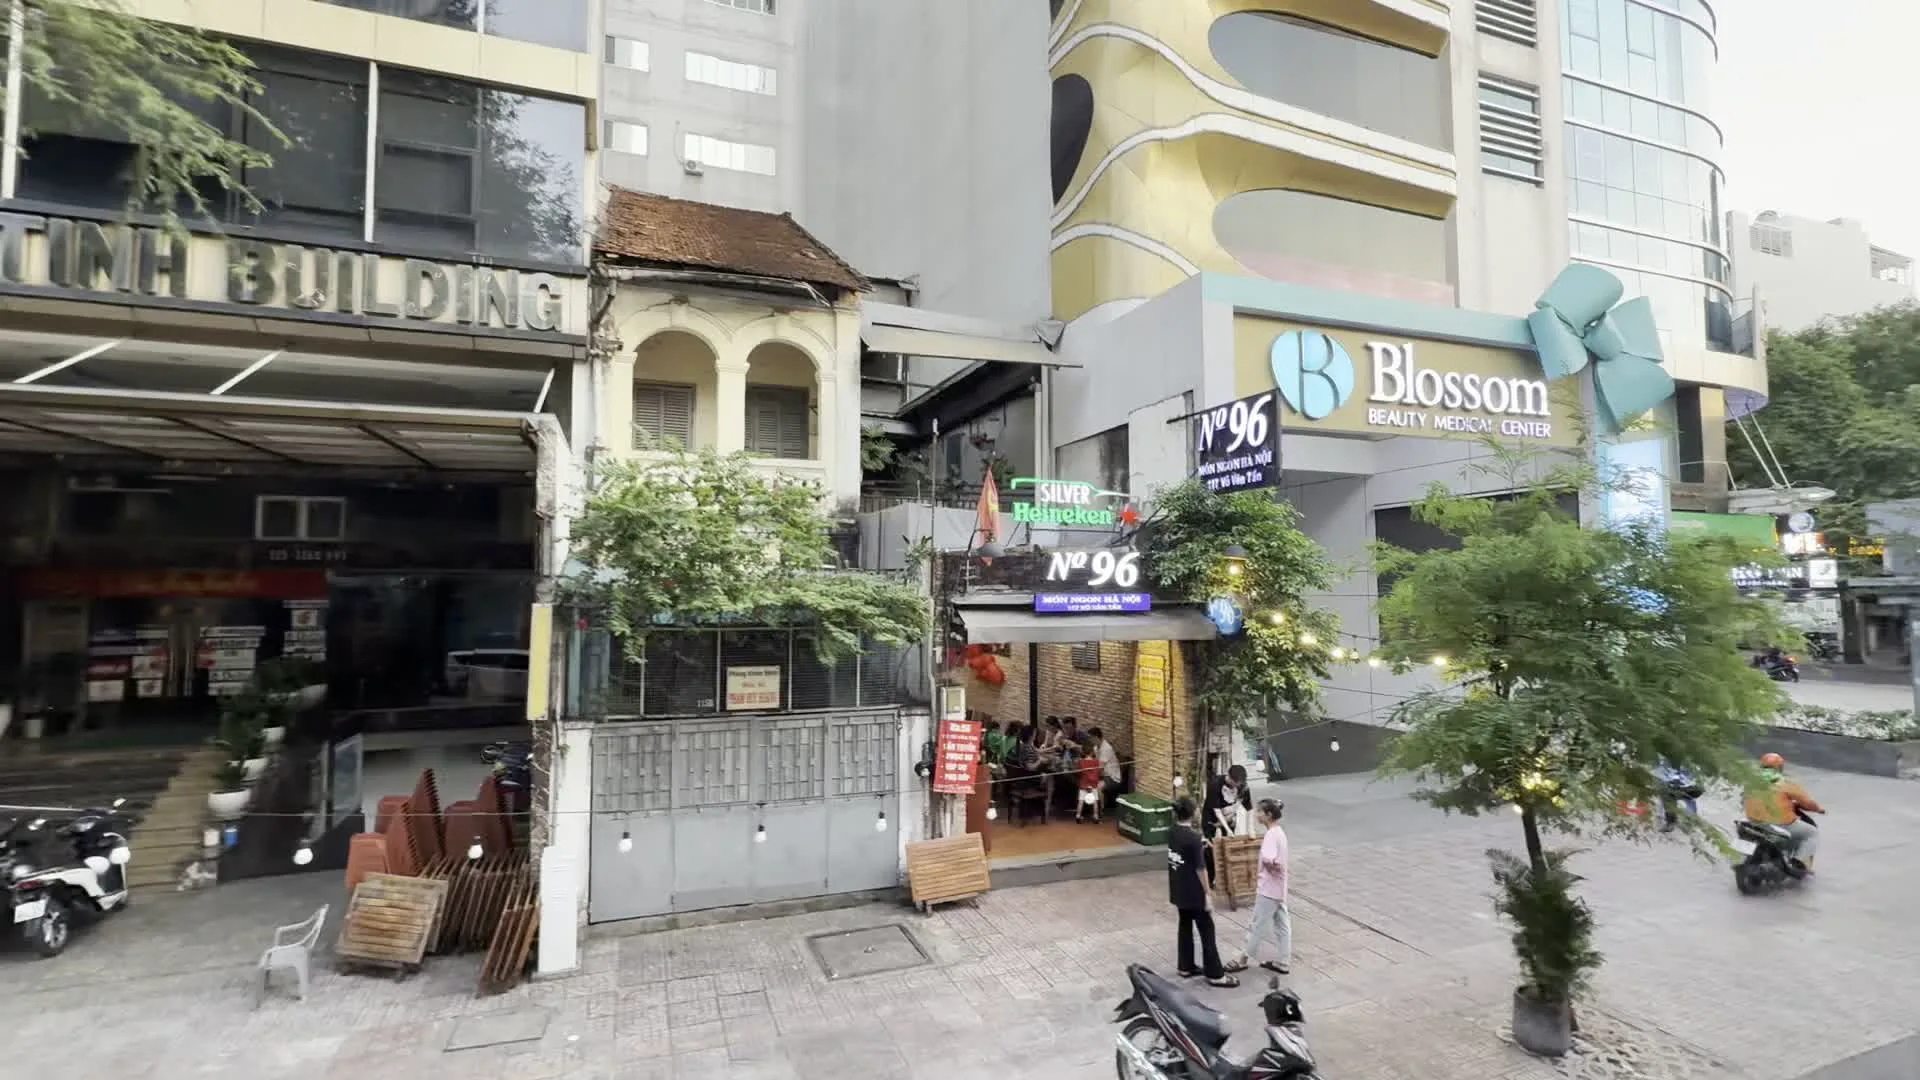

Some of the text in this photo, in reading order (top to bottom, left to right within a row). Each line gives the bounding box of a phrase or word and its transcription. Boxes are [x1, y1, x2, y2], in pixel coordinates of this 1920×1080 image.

[226, 240, 564, 332] BUILDING
[1367, 341, 1551, 417] Blossom
[1226, 394, 1272, 453] 96
[1368, 407, 1427, 428] BEAUTY
[1501, 420, 1552, 438] CENTER
[1040, 483, 1091, 505] SILVER
[1012, 502, 1112, 526] Heineken
[1088, 551, 1140, 587] 96
